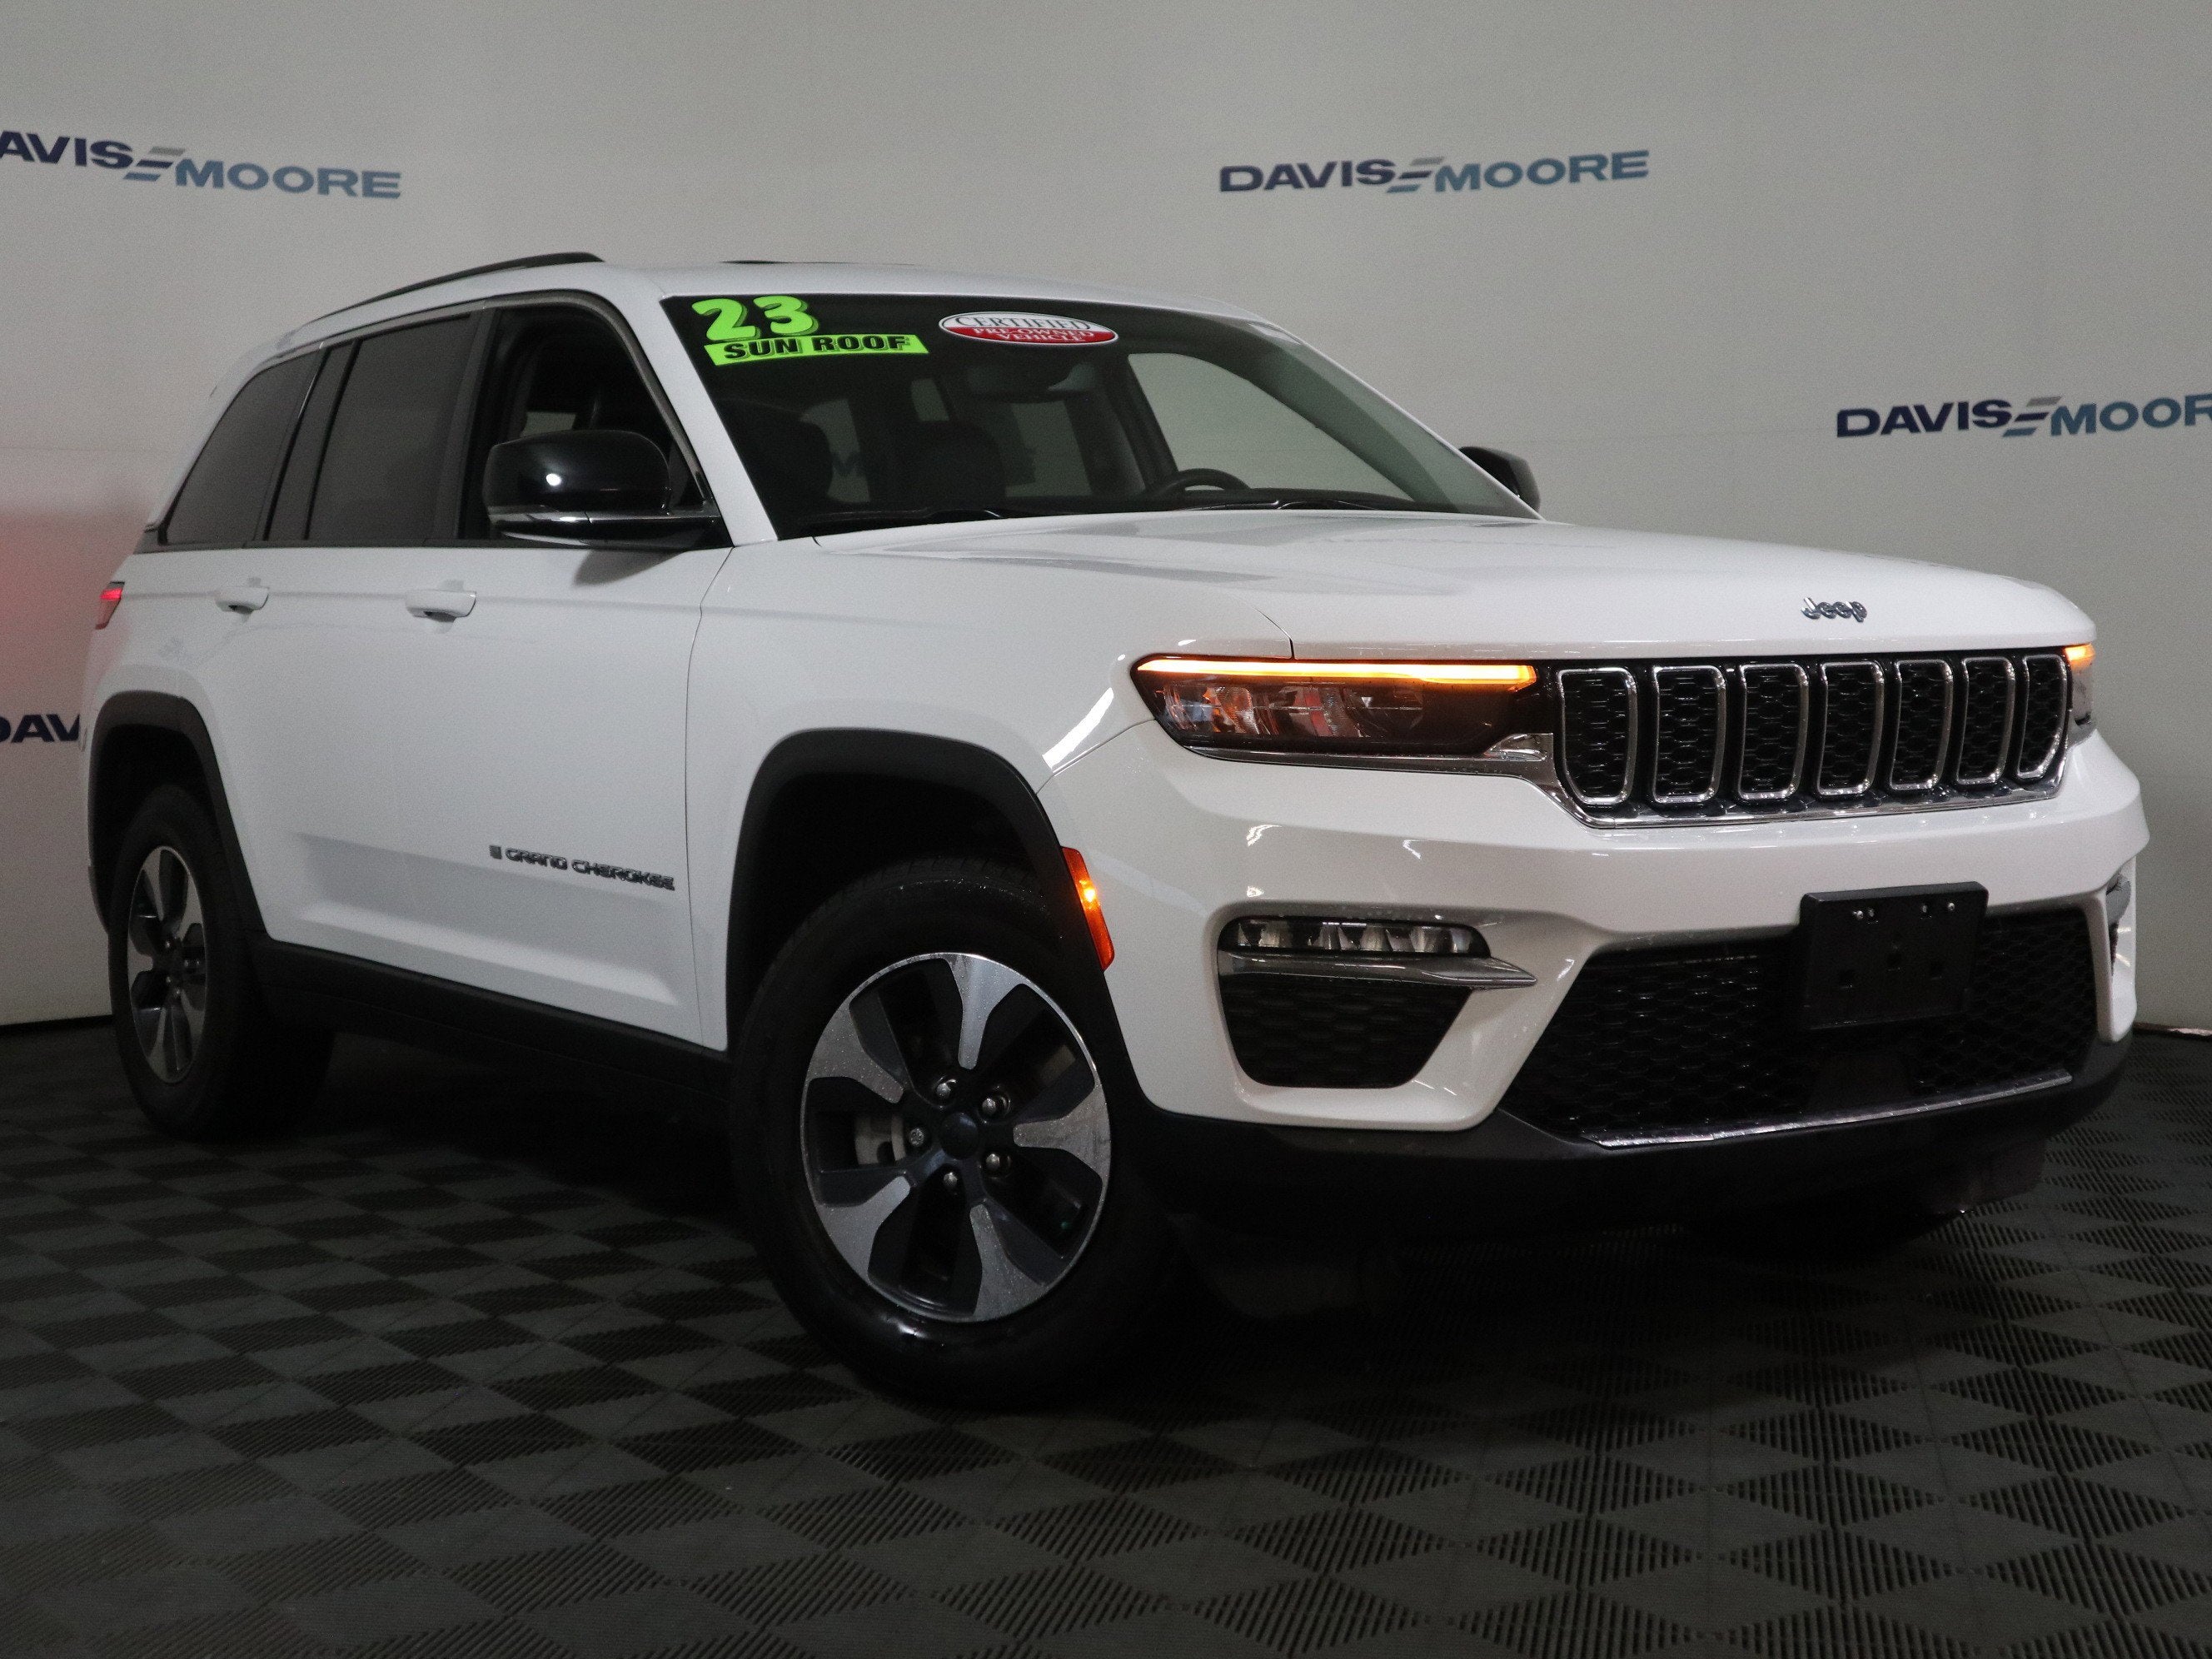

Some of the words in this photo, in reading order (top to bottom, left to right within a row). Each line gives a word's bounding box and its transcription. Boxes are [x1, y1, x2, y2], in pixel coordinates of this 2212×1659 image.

[175, 158, 401, 199] MOORE
[1219, 158, 1397, 192] DAVIS
[1434, 150, 1650, 192] MOORE
[691, 295, 820, 341] 23
[954, 316, 1092, 330] CERTIFIED
[972, 327, 1095, 337] PRE-OWNED
[723, 336, 803, 360] SUN
[811, 335, 911, 353] ROOF
[996, 333, 1087, 342] VEHICLE
[1836, 399, 2013, 438] DAVIS
[1801, 597, 1868, 623] Jeep
[505, 847, 568, 870] GRAND
[570, 859, 675, 891] CHEROKEE
